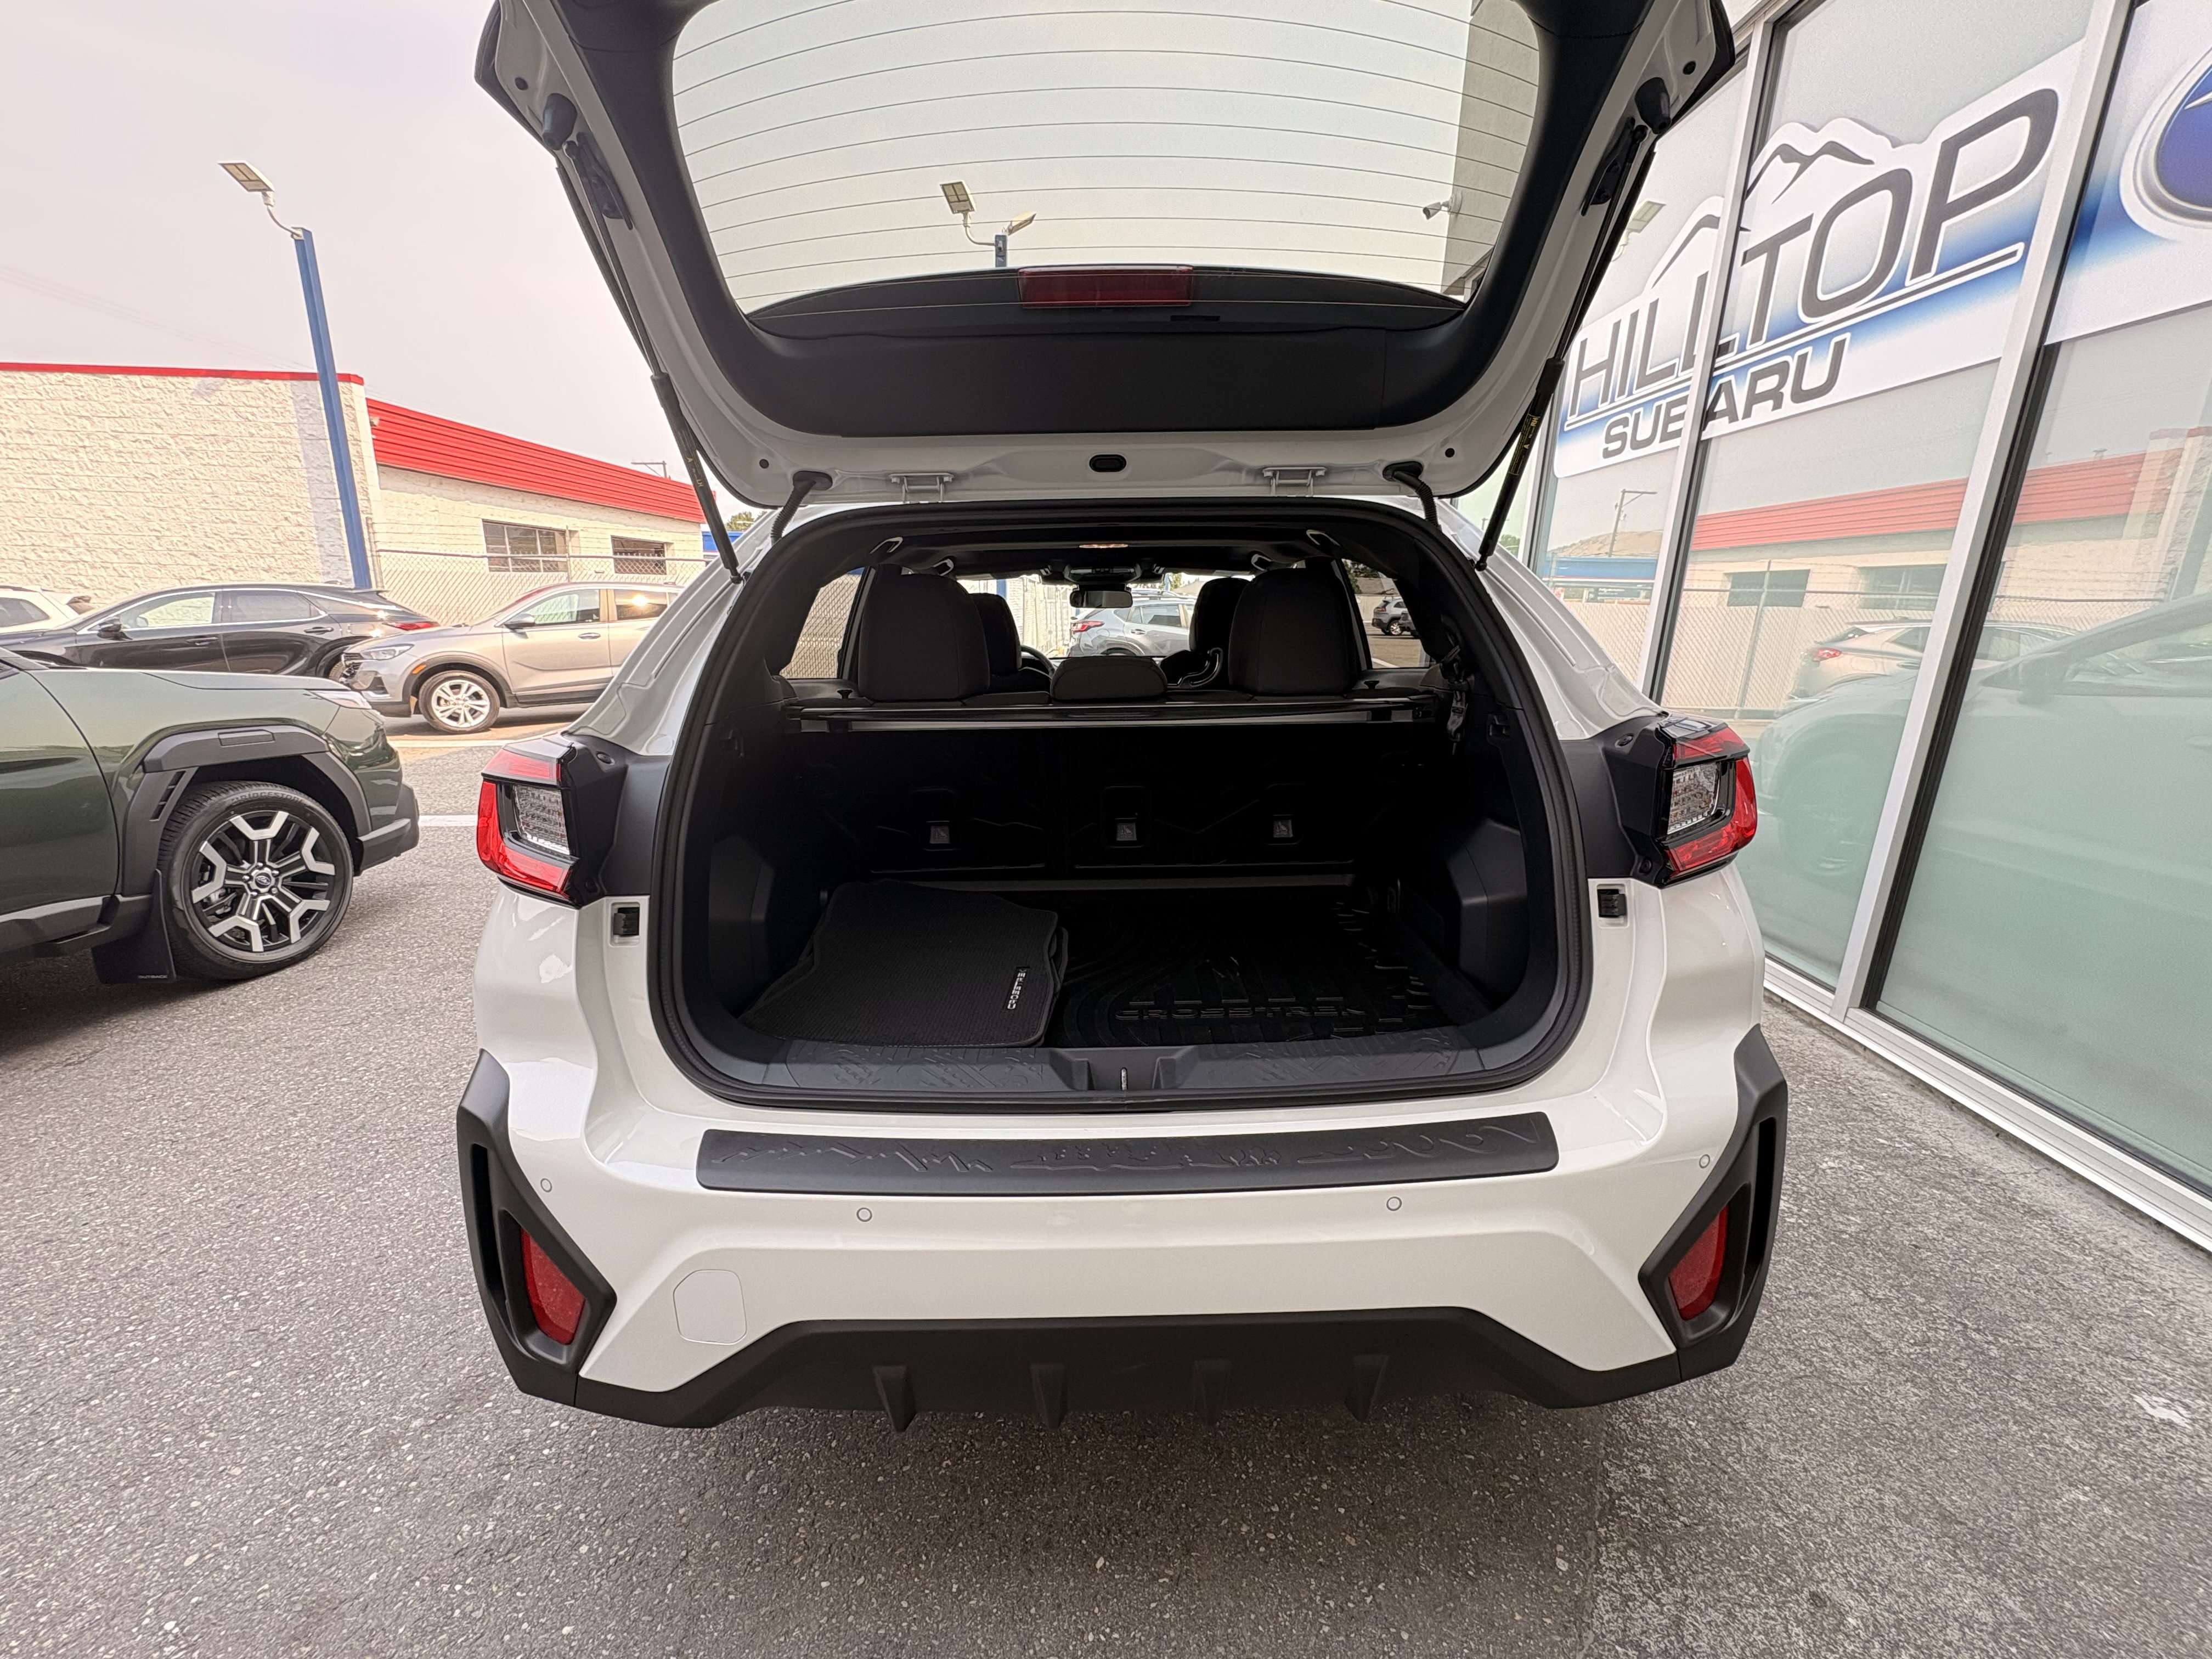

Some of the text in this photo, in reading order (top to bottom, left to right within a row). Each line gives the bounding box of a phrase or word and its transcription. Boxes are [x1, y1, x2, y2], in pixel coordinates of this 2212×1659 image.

[1570, 88, 2058, 417] HILLTOP
[1602, 337, 1847, 459] SUBARU
[231, 792, 306, 805] BRIDGESTON
[1007, 969, 1027, 1009] CROSSTREK
[1115, 1006, 1365, 1020] CROSSTREK
